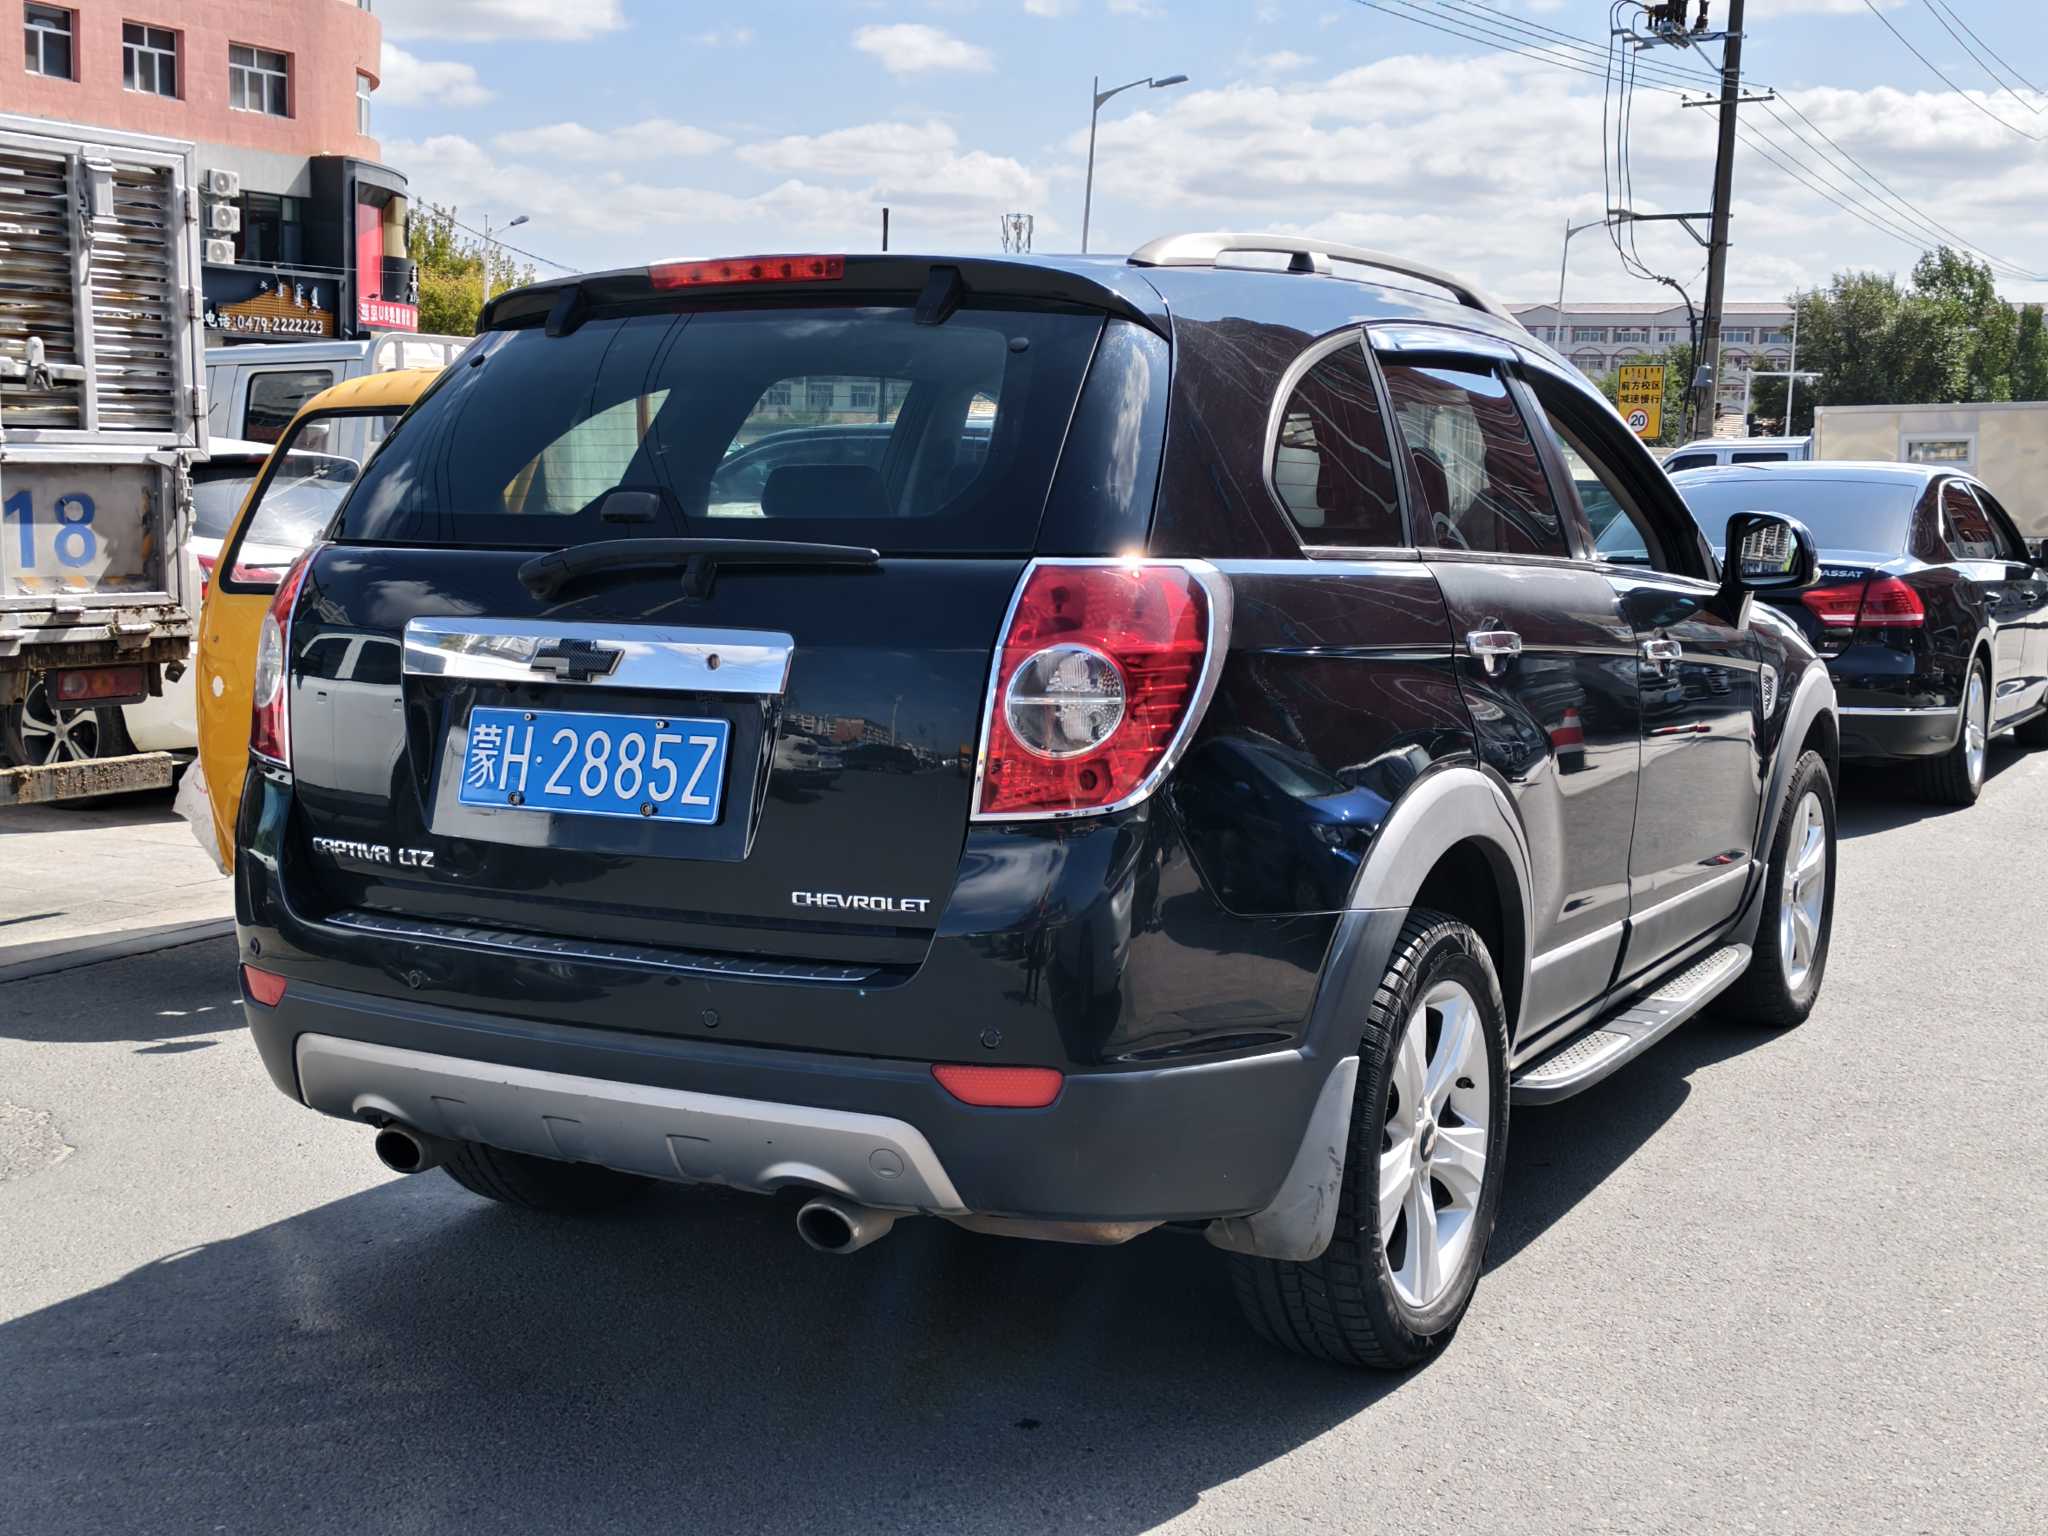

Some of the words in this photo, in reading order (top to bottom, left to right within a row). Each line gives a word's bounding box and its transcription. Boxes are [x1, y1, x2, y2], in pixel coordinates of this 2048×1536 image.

[1621, 381, 1660, 390] 前方校区
[1630, 414, 1646, 427] 20
[3, 489, 97, 569] 18
[1819, 569, 1864, 578] ASSAT
[312, 837, 391, 864] CAPTIVA
[398, 848, 435, 868] LTZ
[791, 891, 931, 912] CHEVROLET
